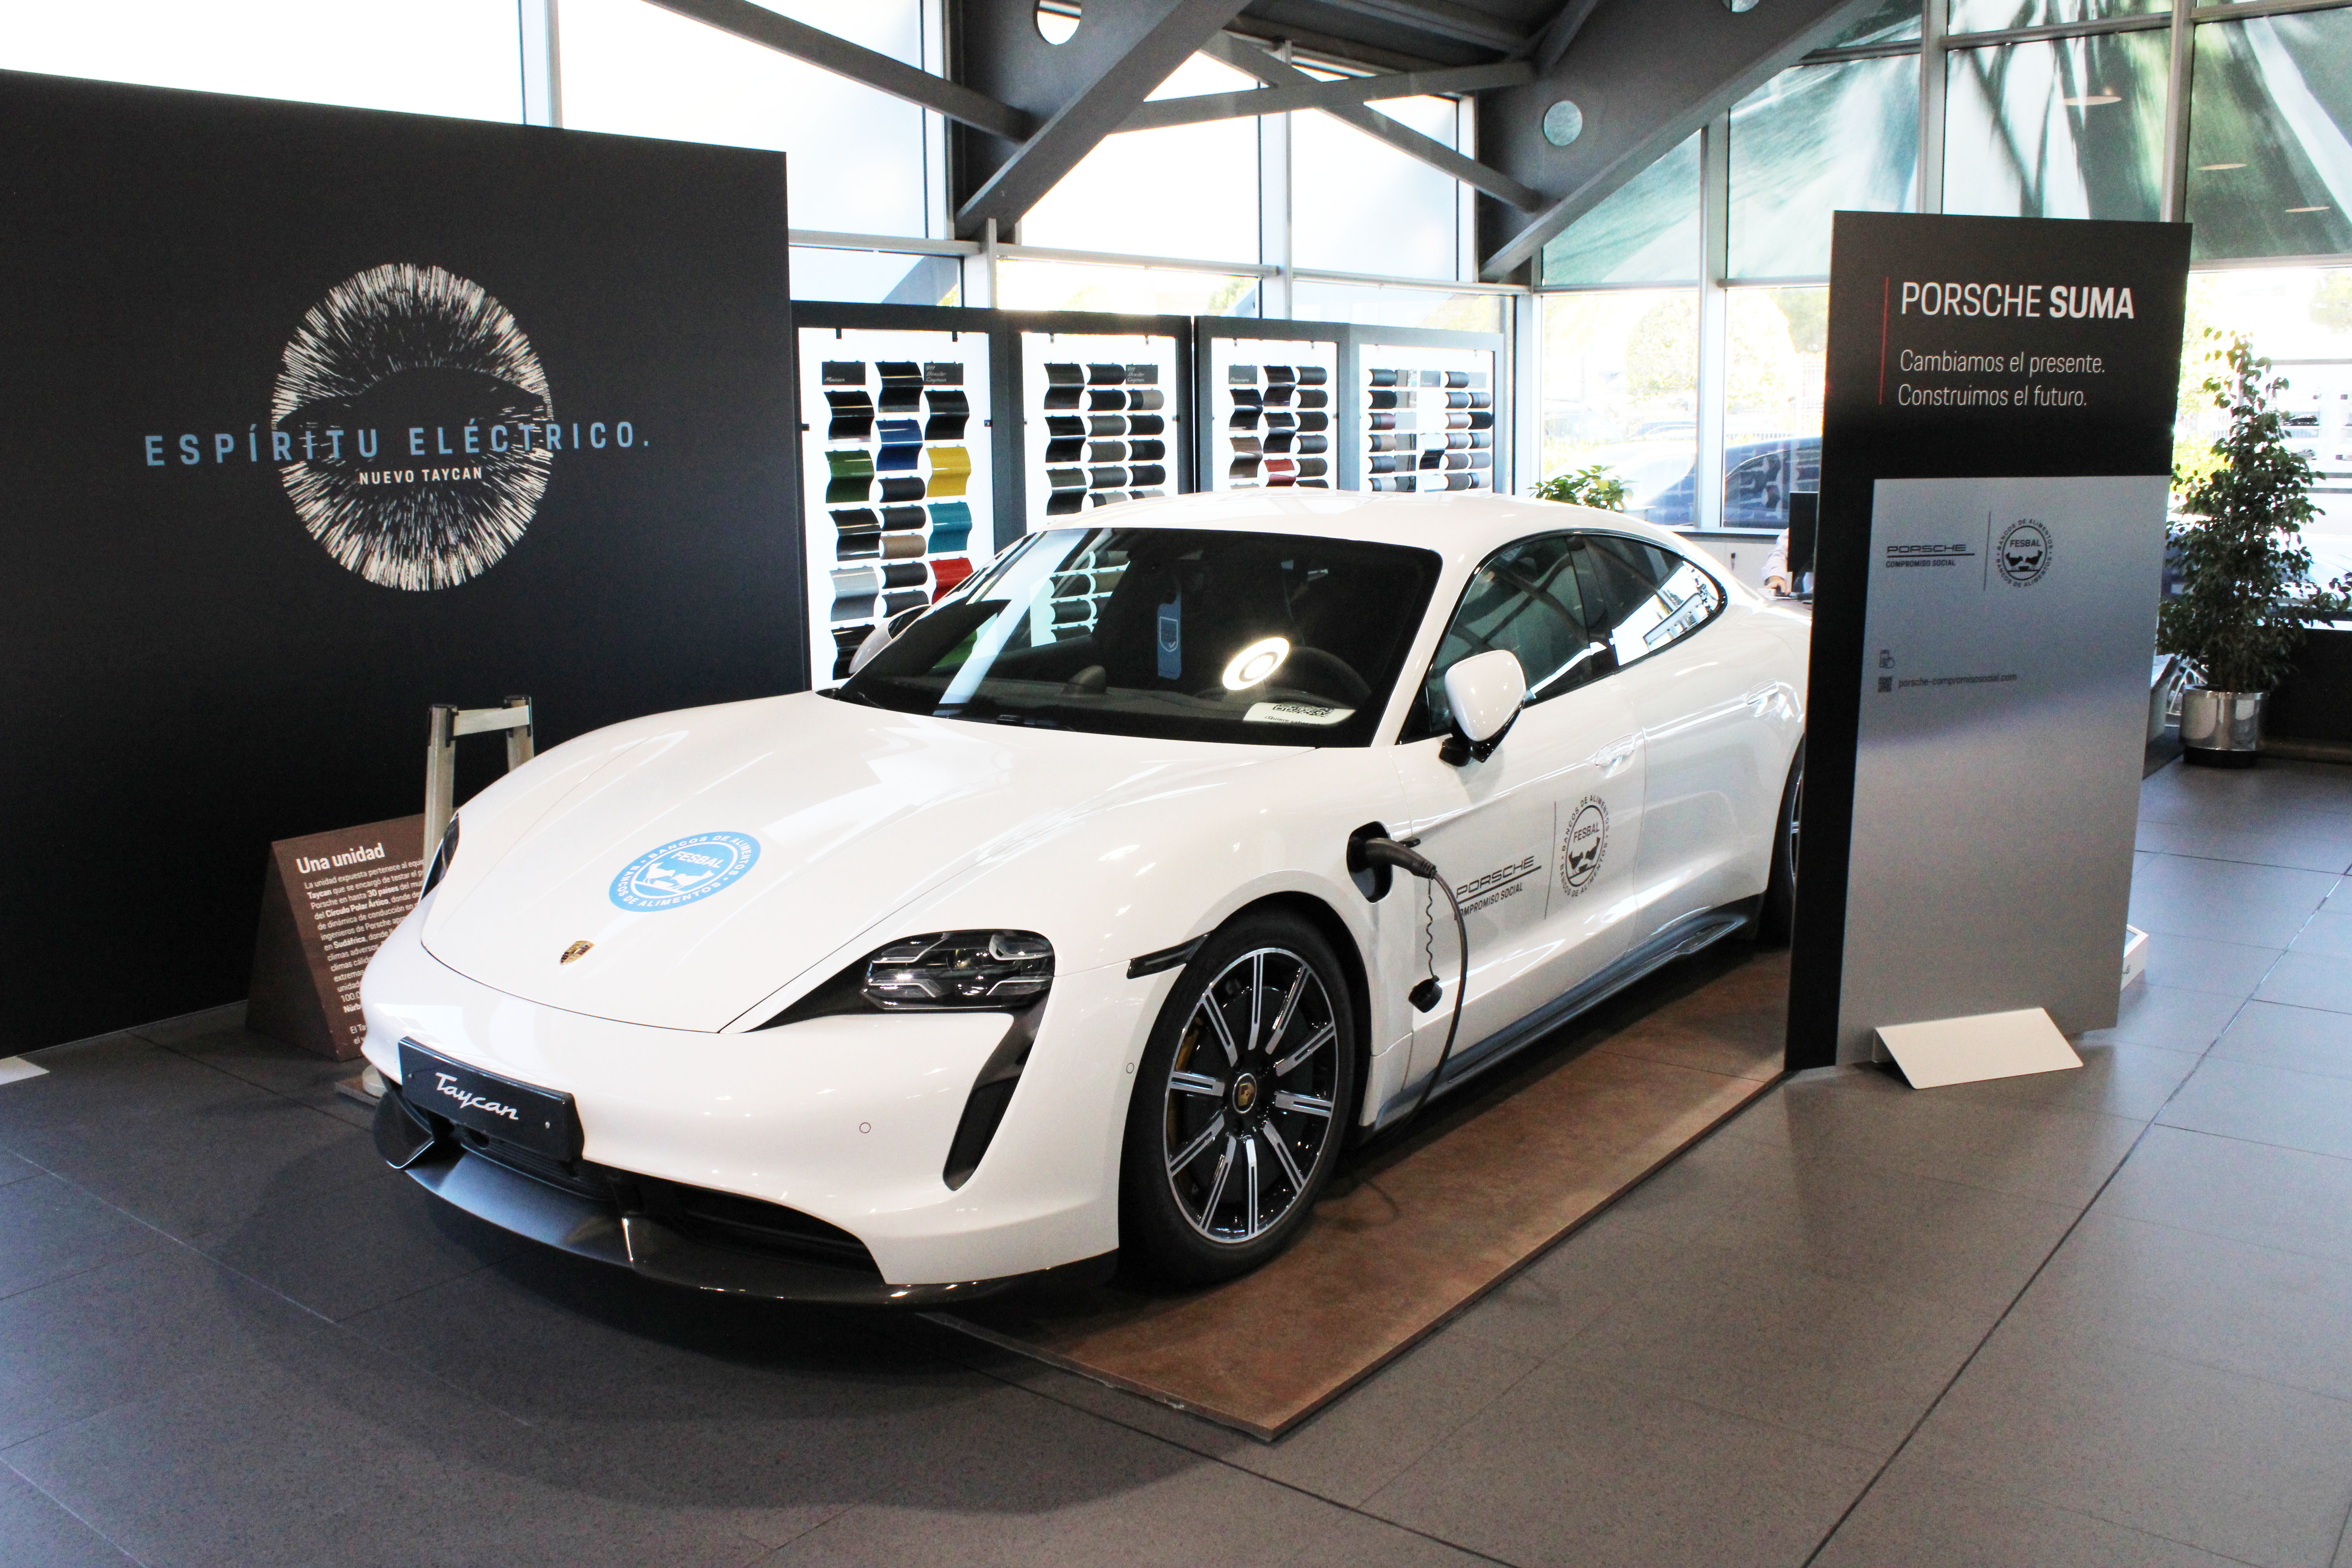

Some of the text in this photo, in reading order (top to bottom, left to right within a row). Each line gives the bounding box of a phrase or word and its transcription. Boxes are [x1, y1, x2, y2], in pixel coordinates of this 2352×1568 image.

[1902, 282, 2134, 319] PORSCHE SUMA
[1900, 350, 2105, 377] Cambiamos el presente.
[1898, 384, 2087, 406] Construimos el futuro.
[145, 418, 649, 466] ESPÍRITU ELÉCTRICO.
[359, 467, 483, 485] NUEVO TAYCAN
[1887, 544, 1966, 553] PORSCHE
[1886, 560, 1931, 568] COMPROMISO
[1898, 674, 2017, 689] porsche-compromisosocial.com
[1580, 797, 1588, 808] DE
[1573, 822, 1600, 842] FESBAL
[296, 842, 385, 873] Una unidad
[648, 836, 708, 859] BANCOS
[730, 838, 752, 876] ALIMENTOS
[670, 851, 724, 868] FESBAL
[307, 889, 332, 900] Taycan
[333, 886, 346, 895] que
[355, 877, 382, 887] encargó
[391, 873, 410, 881] testar
[314, 877, 337, 887] unidad
[338, 871, 368, 882] expuesta
[368, 864, 401, 877] pertenece
[617, 865, 721, 907] BANCOS DE ALIMENTOS
[1456, 856, 1534, 898] PORSCHE
[310, 899, 339, 909] Porsche
[348, 893, 368, 901] hasta
[367, 889, 378, 898] 30
[377, 886, 400, 897] países
[399, 882, 410, 890] del
[1501, 882, 1523, 900] SOCIAL
[314, 911, 325, 920] del
[325, 907, 350, 918] Círculo
[349, 903, 368, 912] Polar
[391, 893, 412, 903] donde
[317, 922, 327, 931] de
[327, 916, 358, 929] dinámica
[367, 906, 405, 919] conducción
[320, 928, 356, 941] ingenieros
[365, 919, 392, 930] Porsche
[368, 931, 389, 941] donde
[327, 944, 379, 962] climas adversos
[330, 961, 353, 972] climas
[334, 970, 364, 982] extremas
[350, 1025, 358, 1034] El
[353, 1036, 361, 1045] el
[436, 1072, 519, 1120] Taycan
